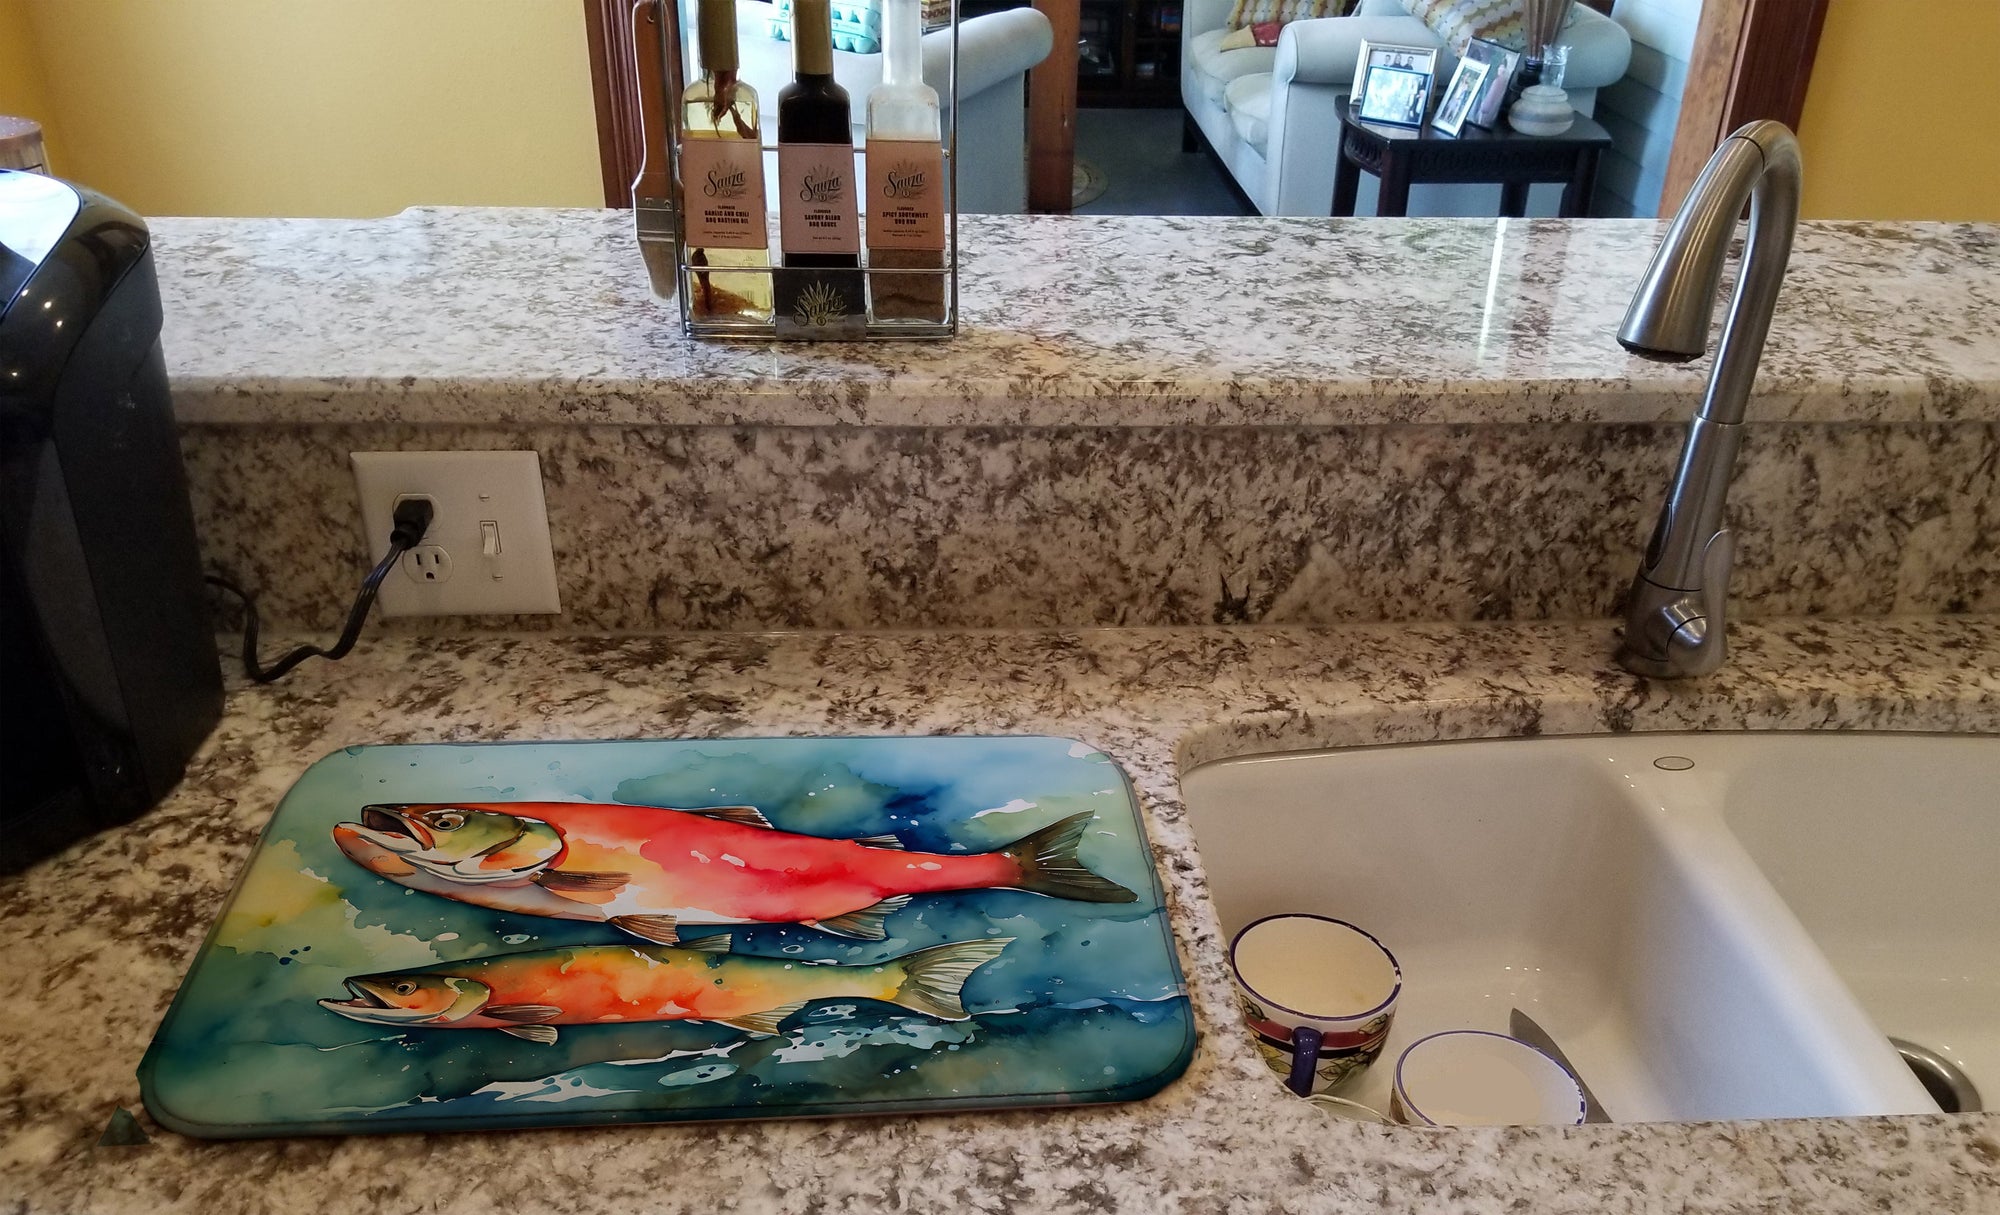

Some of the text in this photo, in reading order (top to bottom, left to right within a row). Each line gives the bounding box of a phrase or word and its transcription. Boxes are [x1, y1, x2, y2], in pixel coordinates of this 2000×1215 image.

[703, 170, 746, 197] Sauza
[800, 175, 842, 202] Sauza
[883, 171, 925, 198] Sauza
[898, 211, 929, 219] SOUTHWEST
[793, 295, 843, 327] Sauza
